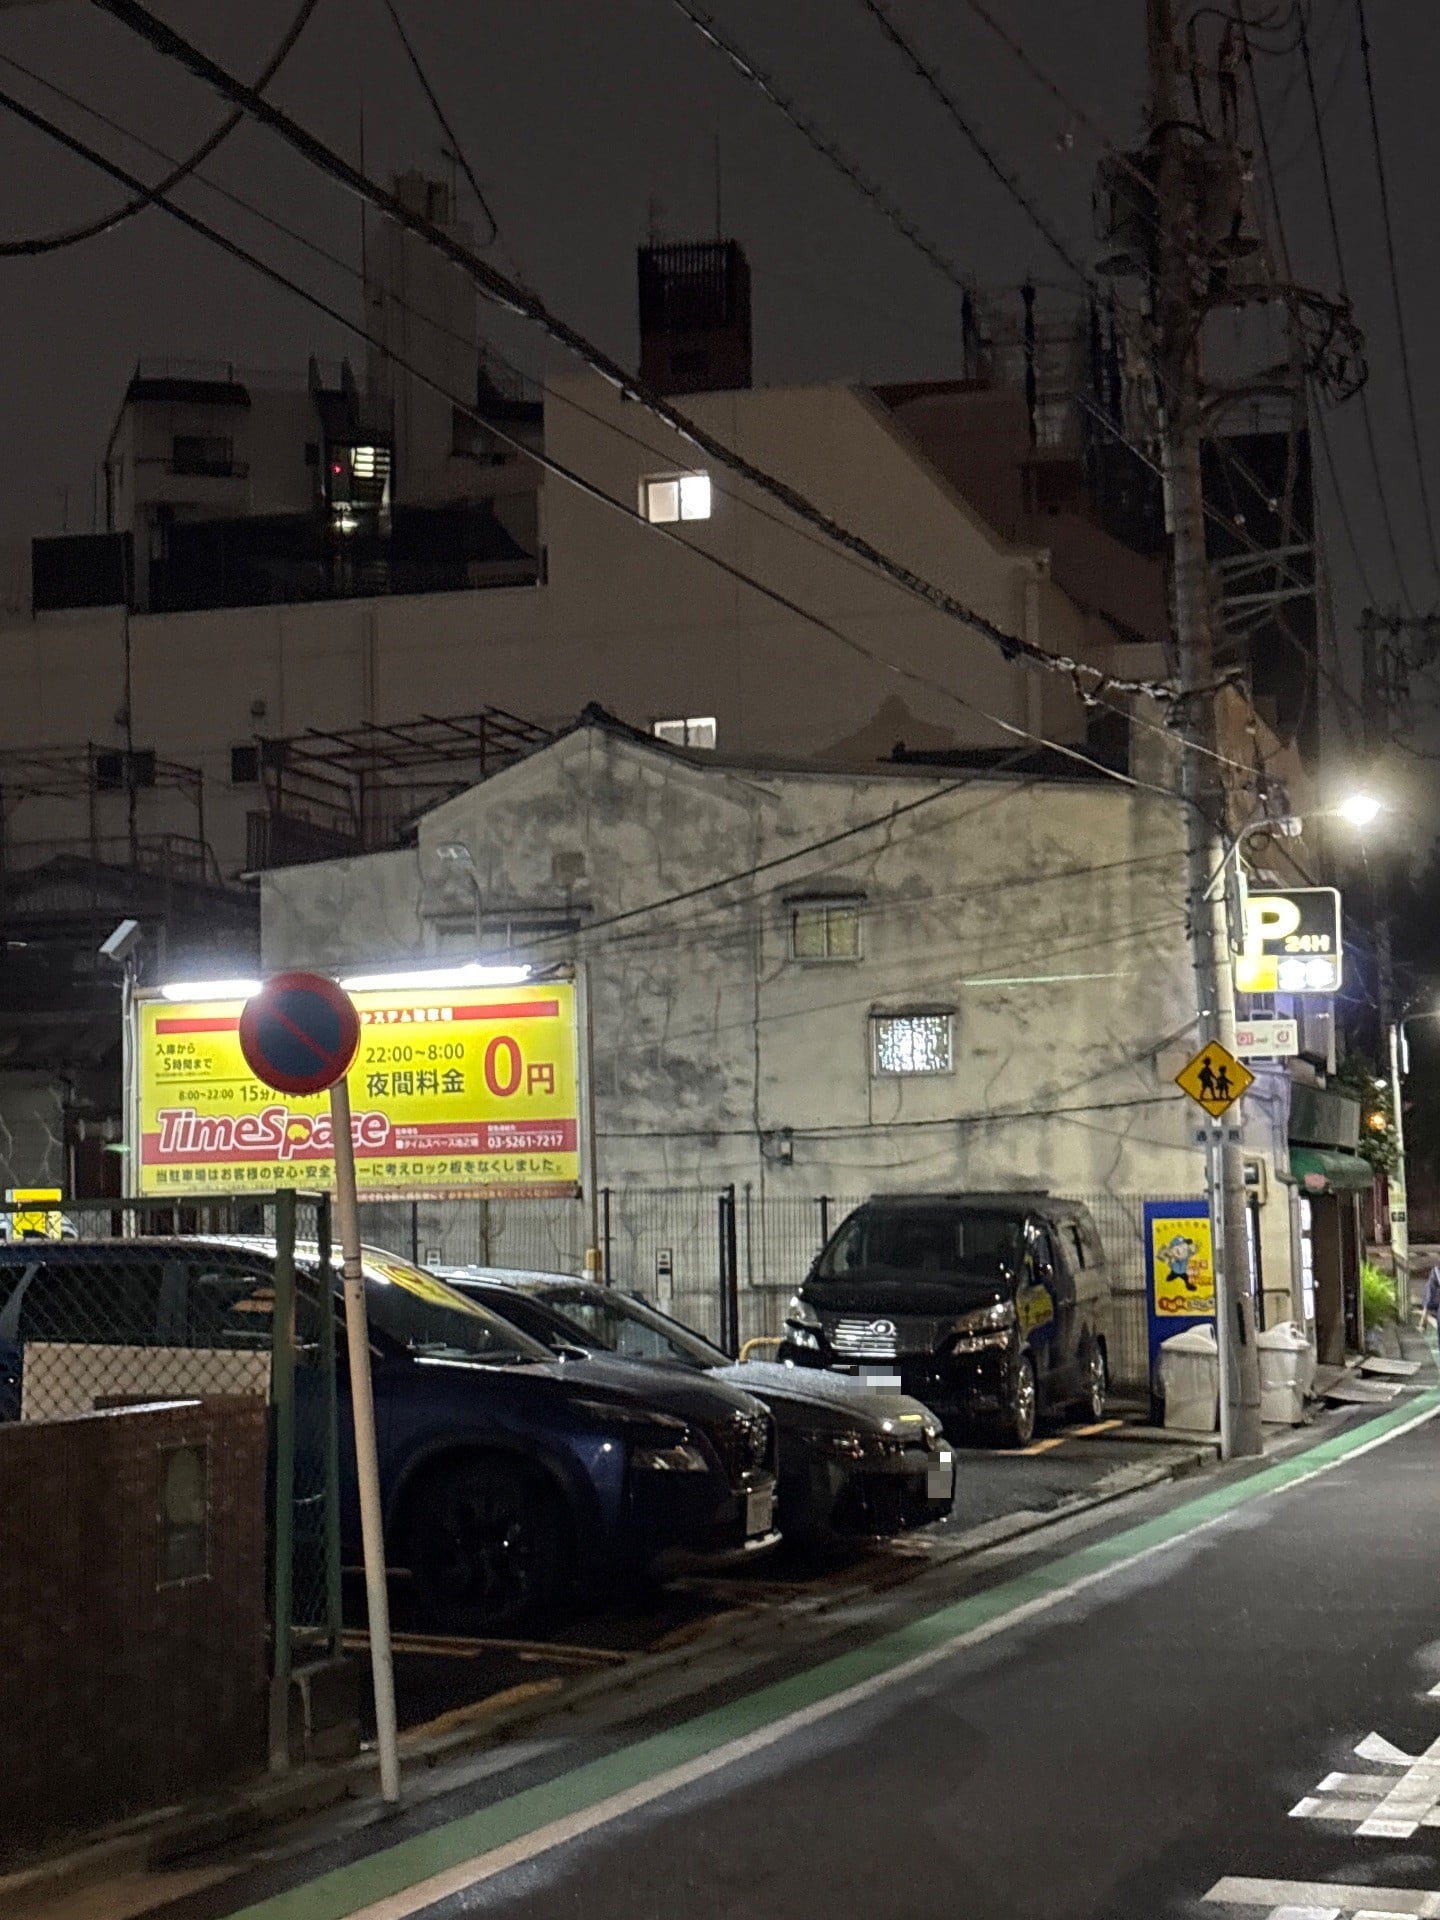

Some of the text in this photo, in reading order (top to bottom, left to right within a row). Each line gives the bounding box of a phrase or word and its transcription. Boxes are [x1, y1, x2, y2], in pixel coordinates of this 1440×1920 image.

[1243, 897, 1300, 956] P
[1285, 934, 1331, 952] 24H
[163, 1057, 213, 1071] 5時間まで
[366, 1068, 465, 1097] 夜間料金
